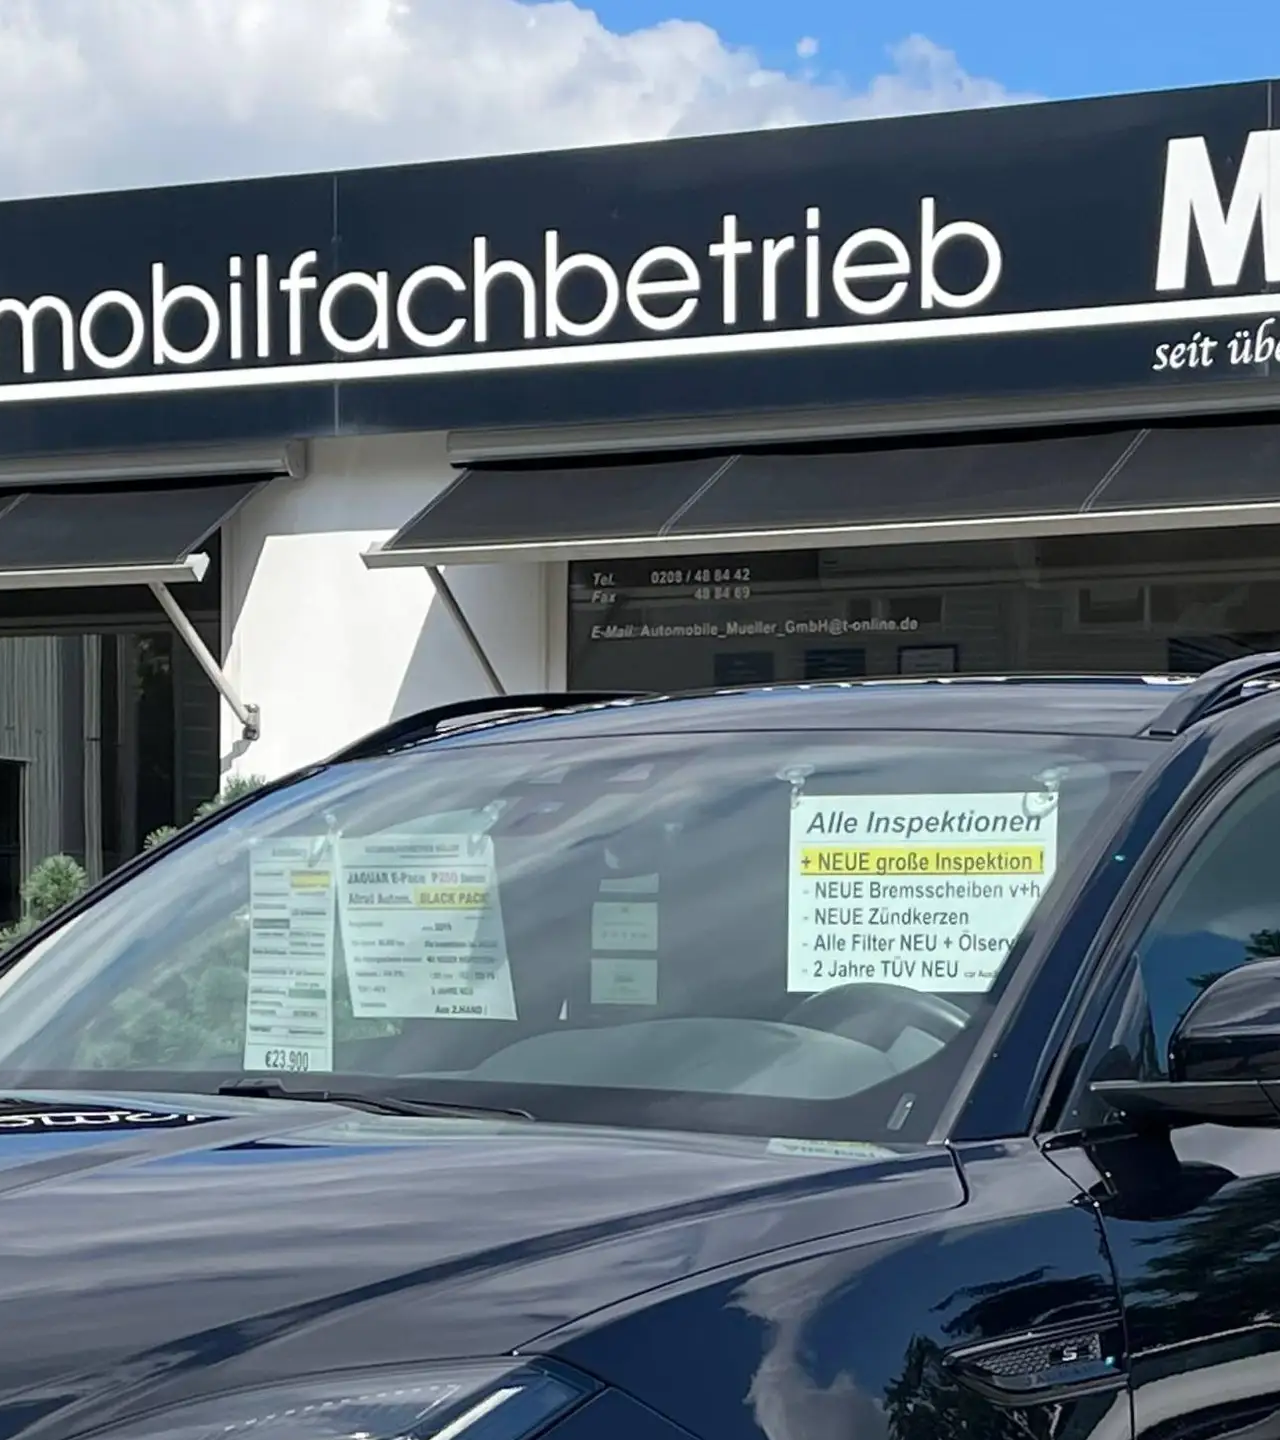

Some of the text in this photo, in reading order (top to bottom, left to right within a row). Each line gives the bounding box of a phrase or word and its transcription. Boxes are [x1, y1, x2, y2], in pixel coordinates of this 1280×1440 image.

[1152, 331, 1218, 372] seit
[694, 569, 710, 582] 48
[734, 567, 751, 581] 42
[591, 590, 617, 604] Fax
[806, 810, 1042, 838] Alle Inspektionen
[818, 852, 870, 871] NEUE
[876, 851, 929, 875] große
[936, 850, 1033, 874] Inspektion
[814, 878, 1041, 899] NEUE Bremsscheiben v+h
[814, 904, 969, 927] NEUE Zündkerzen
[813, 932, 847, 952] Alle
[851, 932, 896, 952] Filter
[899, 932, 938, 952] NEU
[812, 960, 822, 978] 2
[827, 959, 875, 978] Jahre
[880, 956, 915, 978] TÜV
[921, 960, 959, 978] NEU
[1062, 1346, 1078, 1361] S
